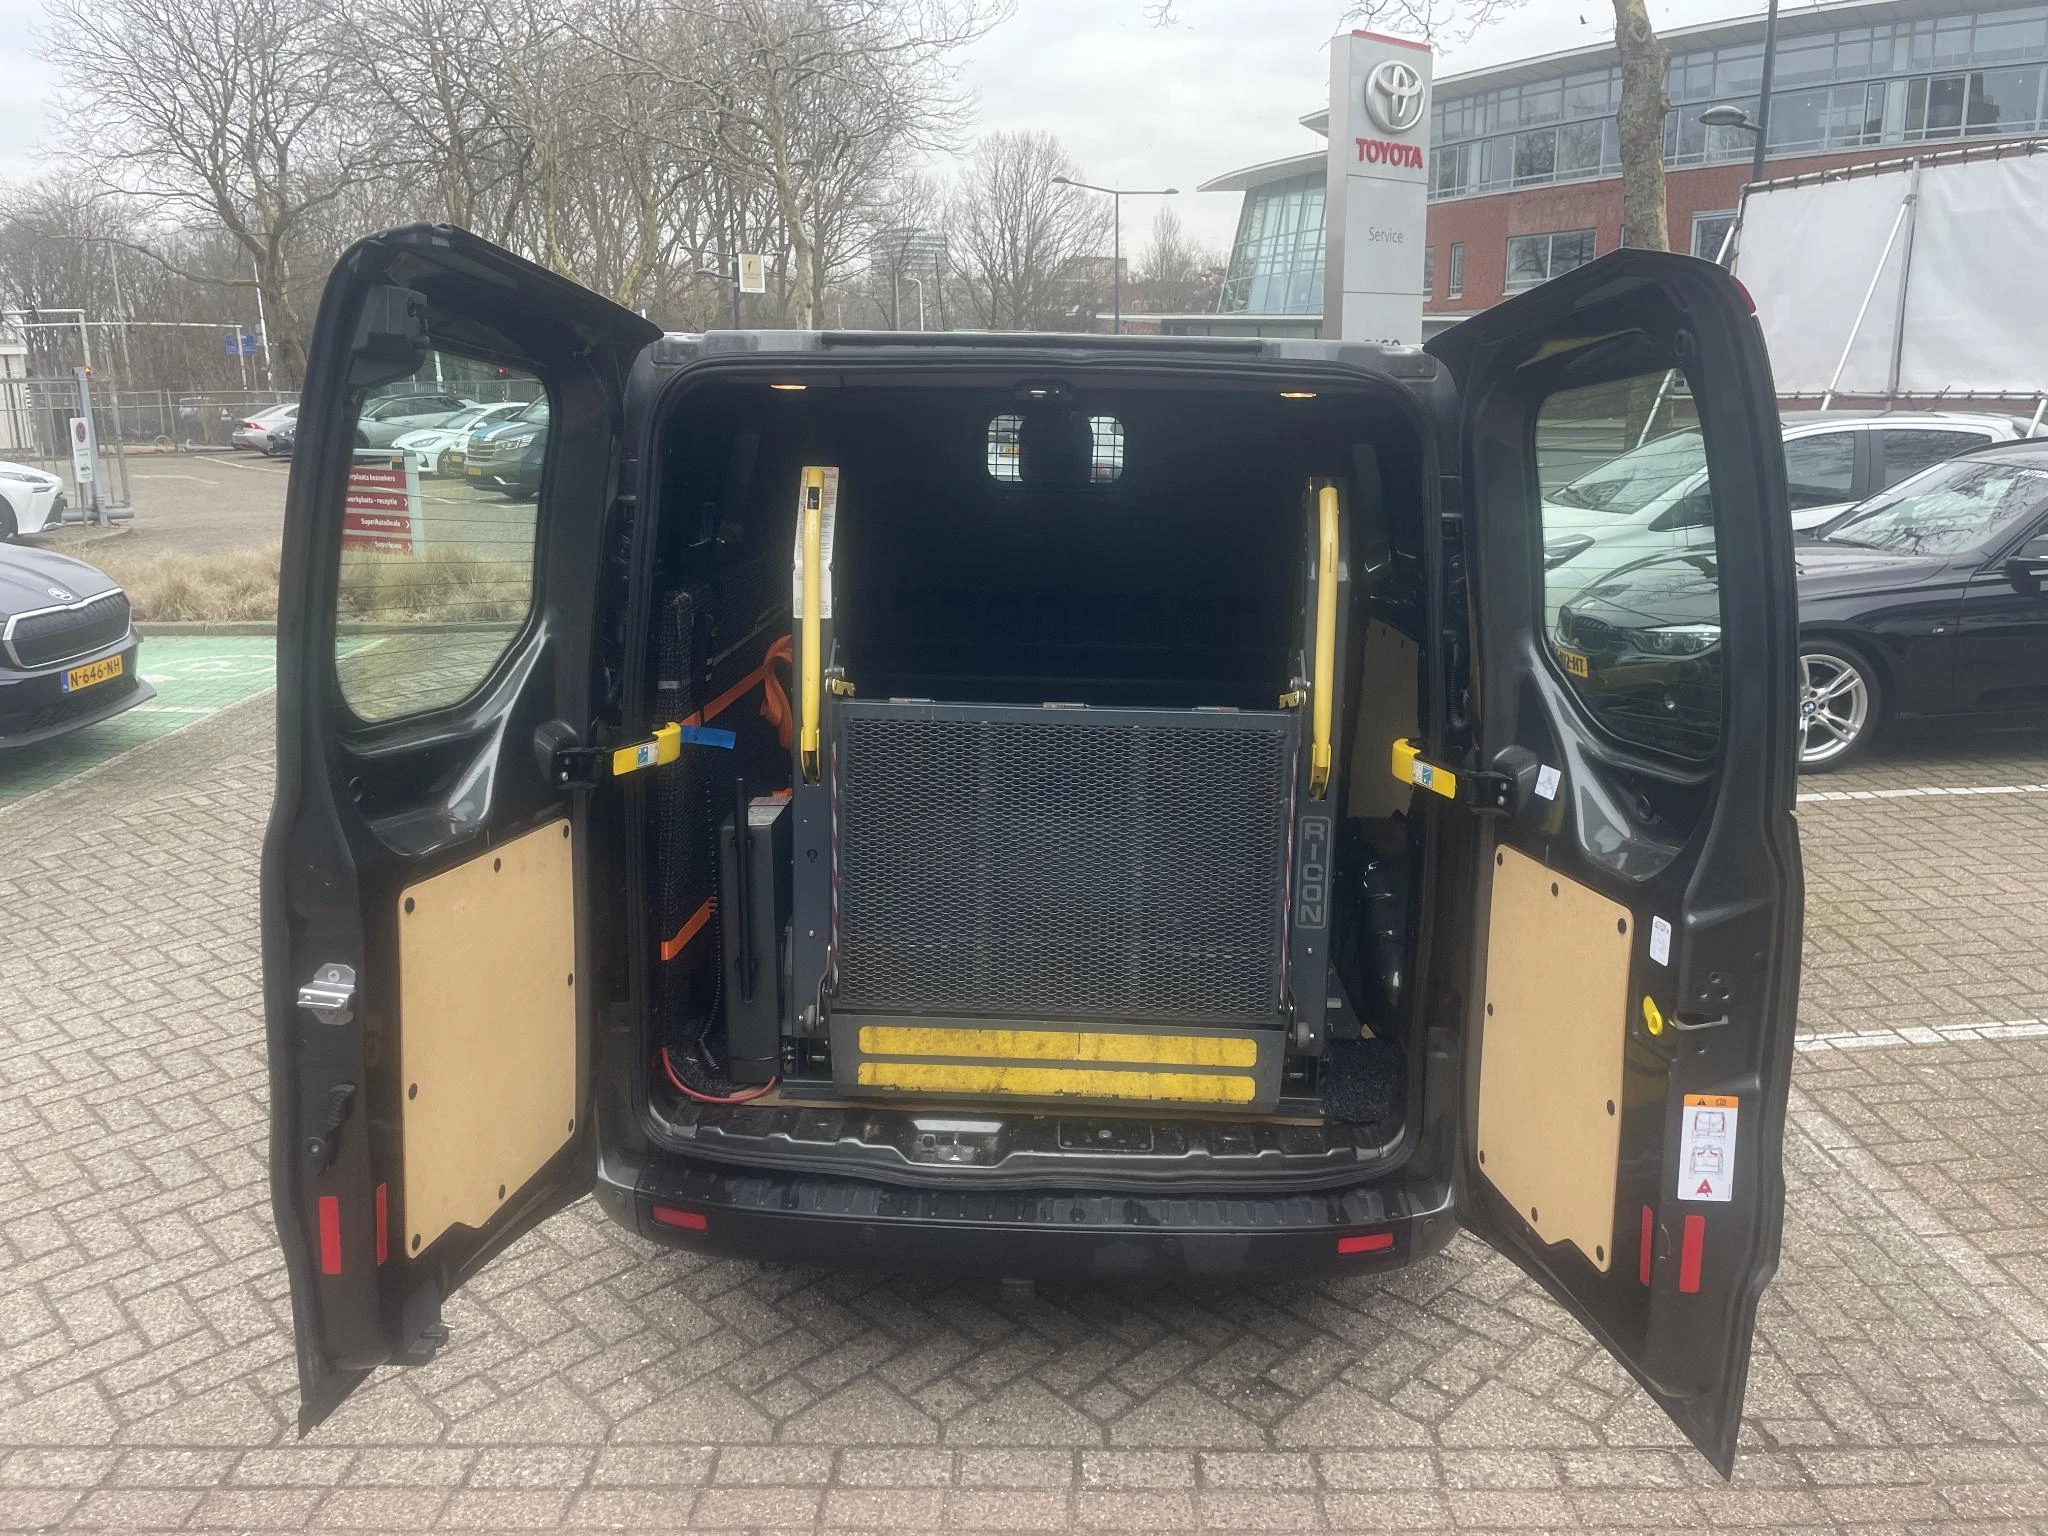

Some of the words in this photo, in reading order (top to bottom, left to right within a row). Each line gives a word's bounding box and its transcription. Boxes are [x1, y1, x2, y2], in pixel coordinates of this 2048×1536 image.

[1356, 138, 1423, 169] TOYOTA
[1368, 226, 1404, 244] Service
[70, 658, 121, 688] N-646-NH
[1300, 822, 1326, 922] RICON
